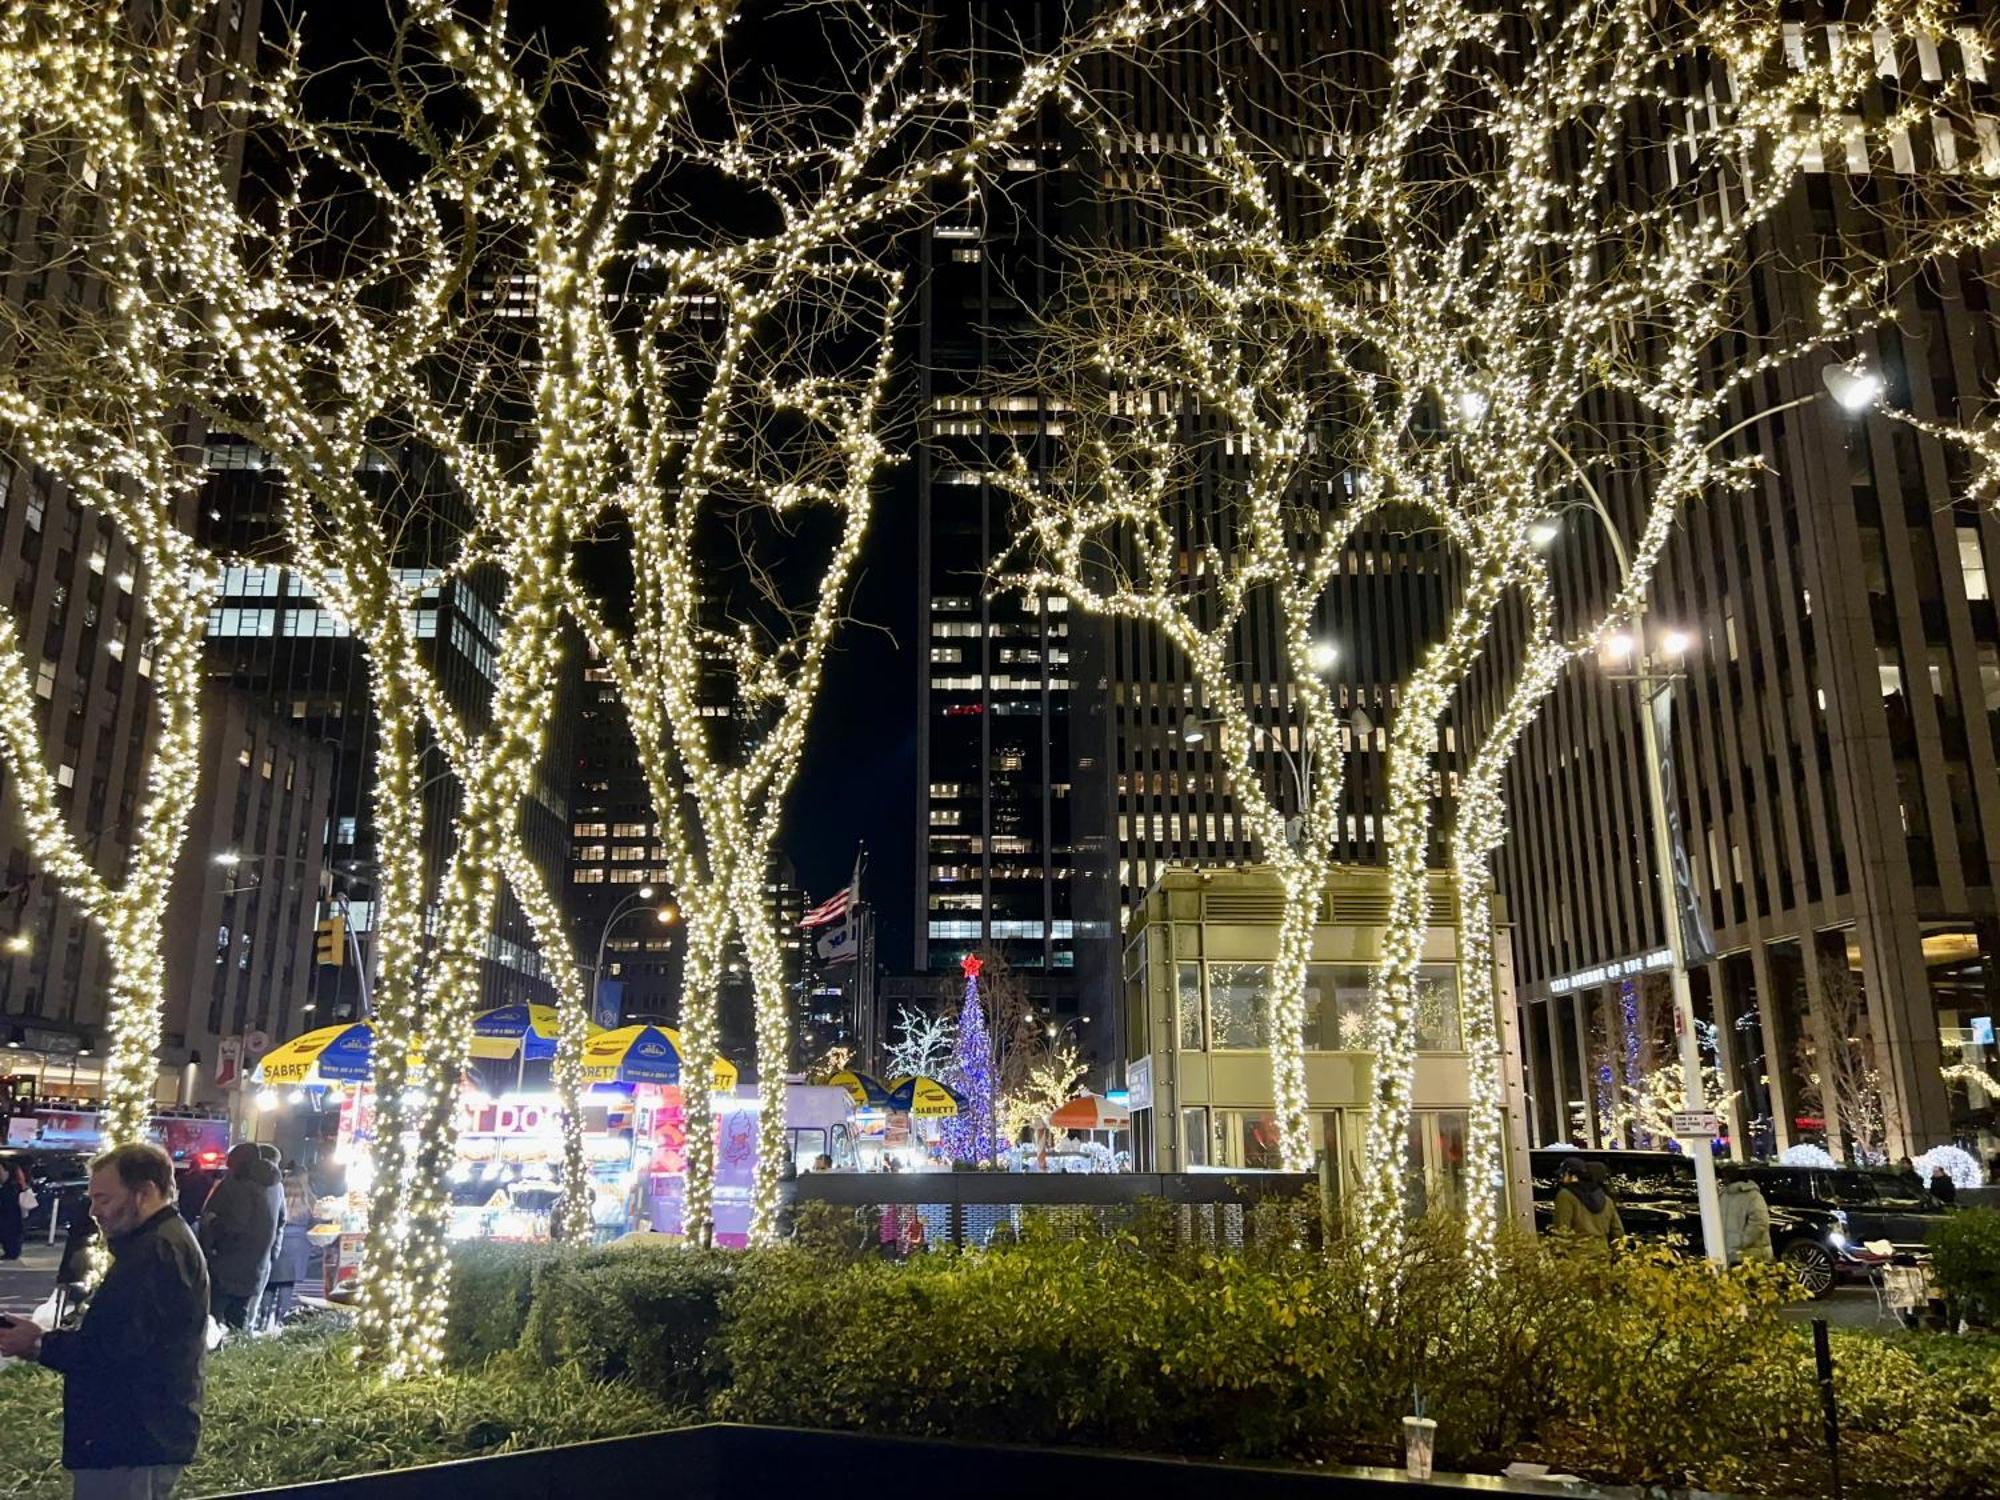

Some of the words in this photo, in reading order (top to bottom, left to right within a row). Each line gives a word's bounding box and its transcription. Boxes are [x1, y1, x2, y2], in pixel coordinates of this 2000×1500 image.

[1571, 967, 1606, 988] AVENUE
[1607, 963, 1621, 978] OF
[1623, 958, 1643, 974] THE
[916, 1106, 954, 1114] SABRETT
